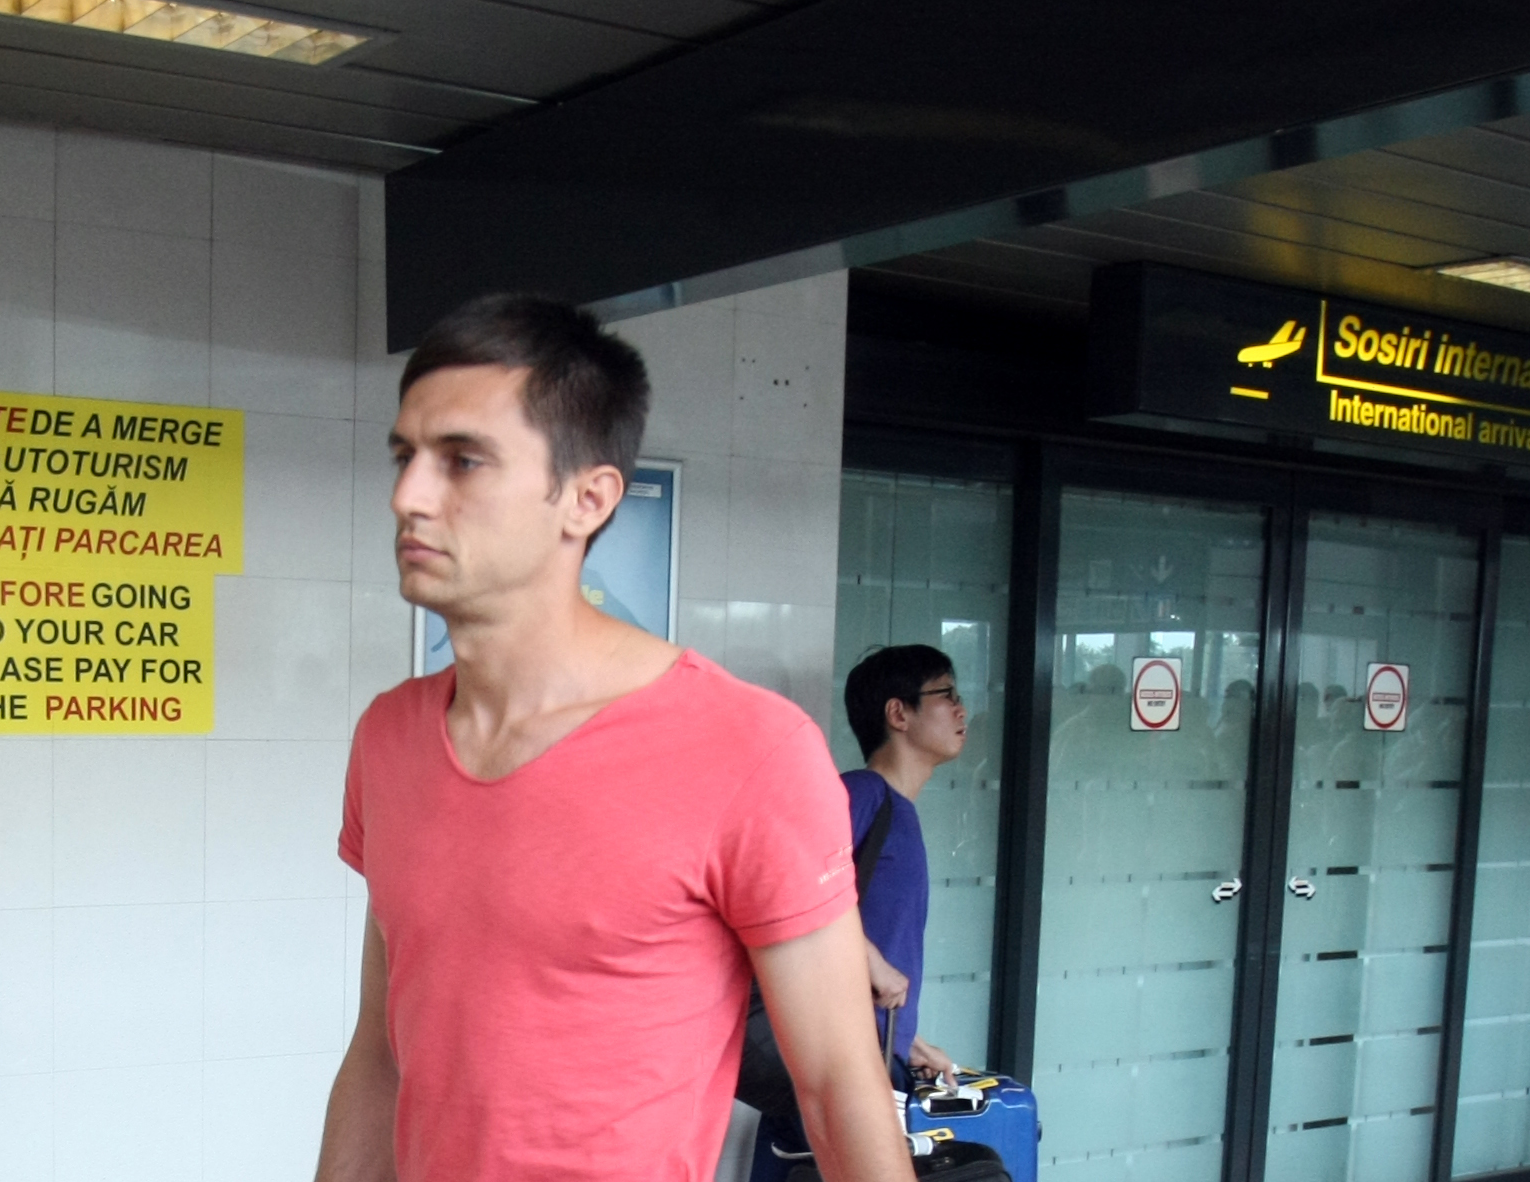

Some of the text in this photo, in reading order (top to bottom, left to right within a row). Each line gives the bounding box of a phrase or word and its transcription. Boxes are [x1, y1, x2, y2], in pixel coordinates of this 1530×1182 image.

[1334, 314, 1432, 370] Sosiri
[29, 409, 75, 436] DE
[81, 413, 103, 439] A
[112, 415, 224, 447] MERGE
[1330, 389, 1474, 440] International
[28, 484, 147, 517] RUGĂM
[53, 526, 224, 559] PARCAREA
[91, 583, 192, 610] GOING
[14, 618, 105, 645] YOUR
[114, 621, 180, 647] CAR
[74, 658, 132, 684] PAY
[141, 659, 203, 684] FOR
[45, 695, 183, 722] PARKING
